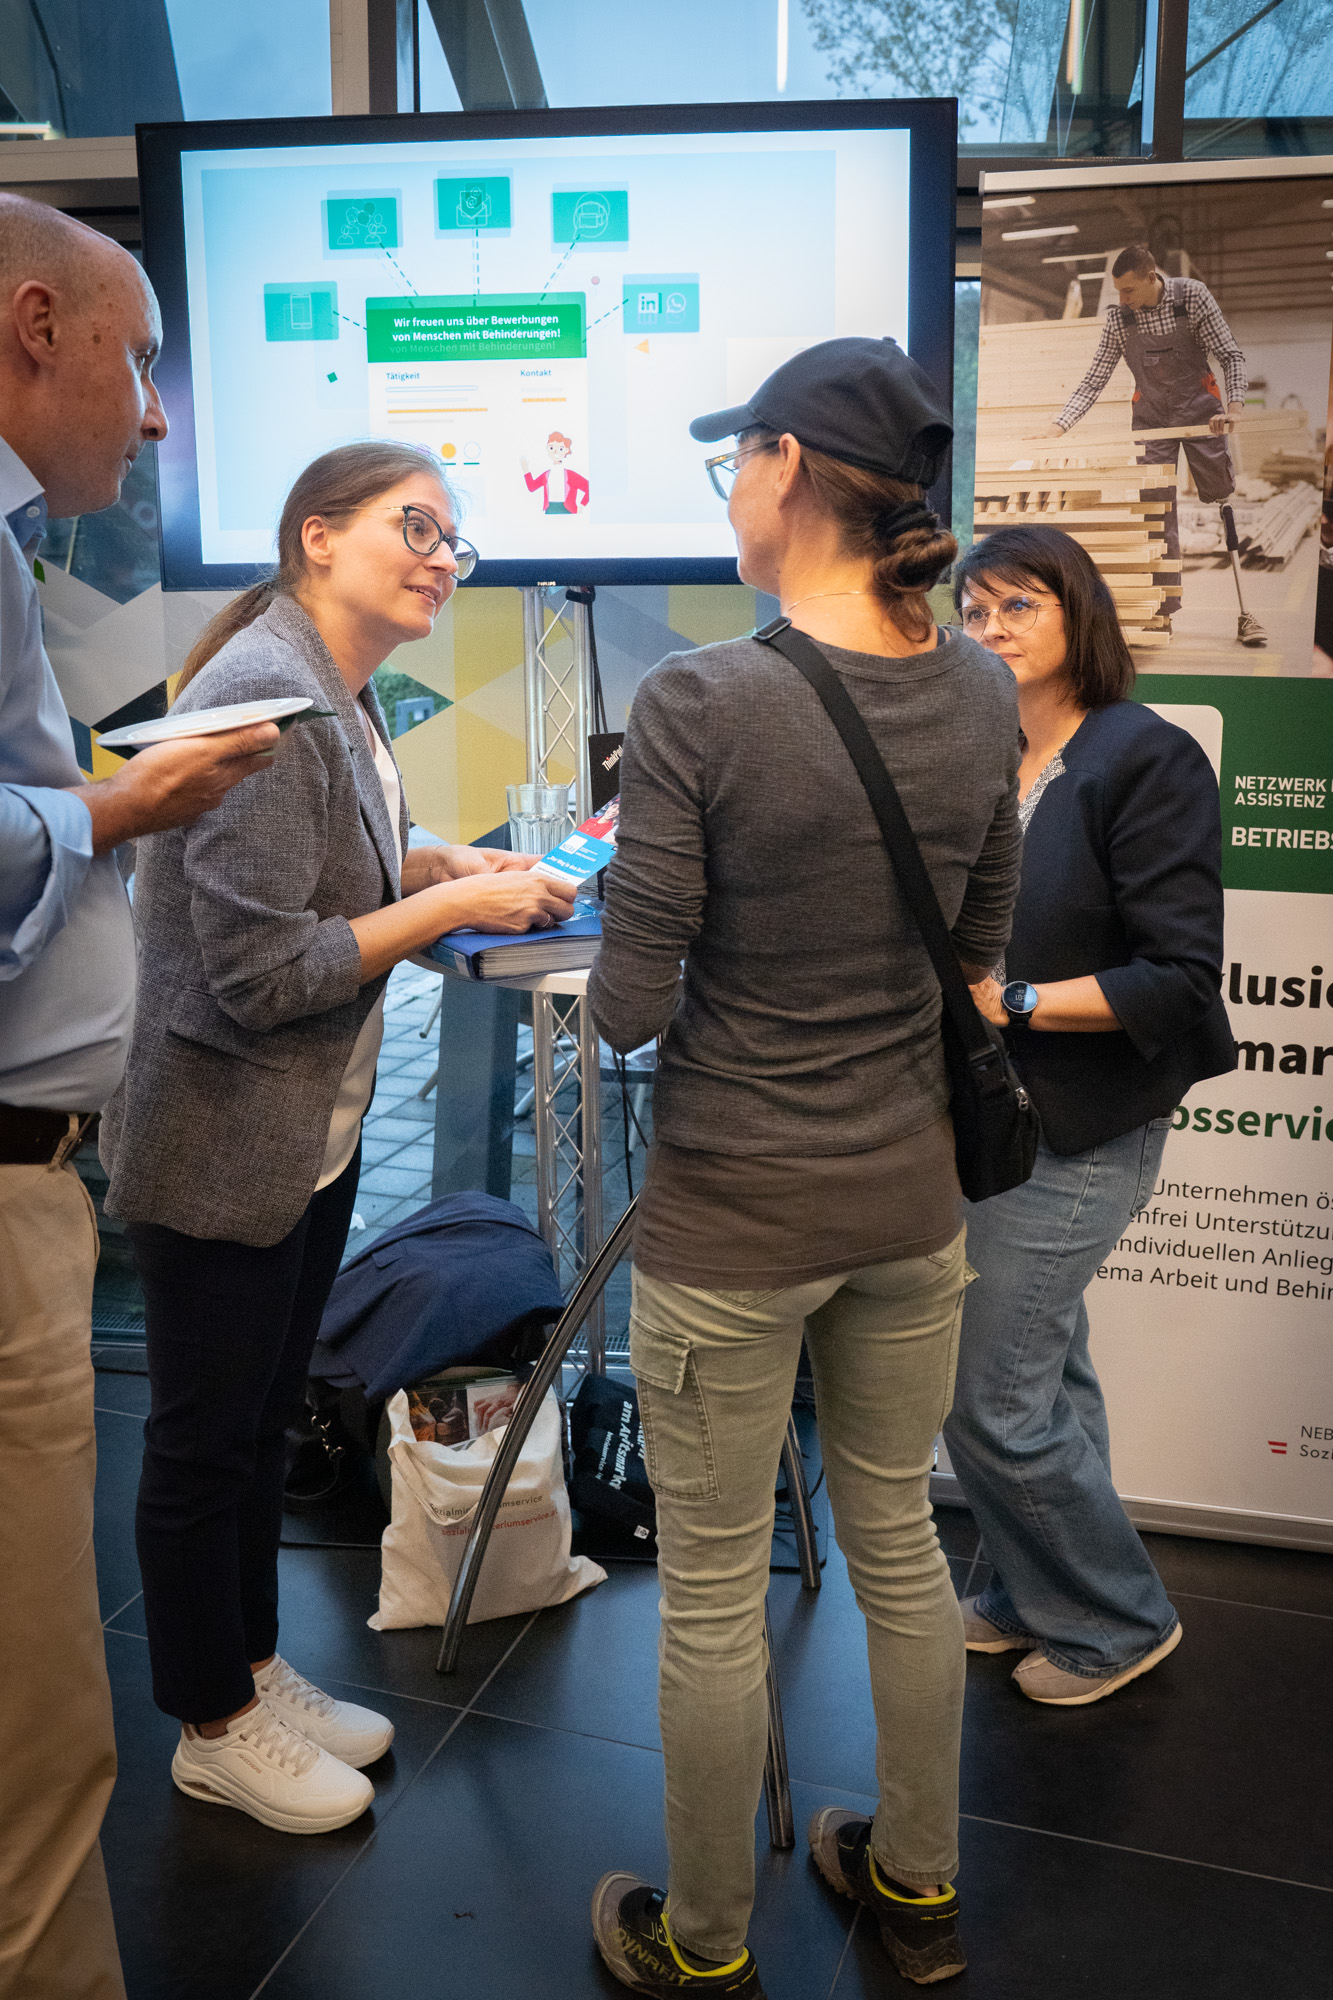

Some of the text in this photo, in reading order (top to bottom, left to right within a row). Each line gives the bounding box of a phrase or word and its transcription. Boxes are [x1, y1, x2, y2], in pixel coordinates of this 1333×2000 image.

[393, 315, 559, 328] Wir freuen uns über Bewerbungen
[392, 328, 561, 342] von Menschen mit Behinderungen!
[386, 372, 420, 382] Tätigkeit
[520, 369, 552, 377] Kontakt
[1234, 775, 1327, 793] NETZWERK
[1234, 791, 1326, 809] ASSISTENZ
[1231, 826, 1333, 850] BETRIEB
[1222, 962, 1333, 1009] lusi
[1131, 1207, 1333, 1241] nfrei Unterstützu
[1262, 1247, 1333, 1276] Anlieg
[1150, 1267, 1218, 1290] Arbeit
[1225, 1276, 1268, 1295] und
[1300, 1425, 1333, 1441] NEB
